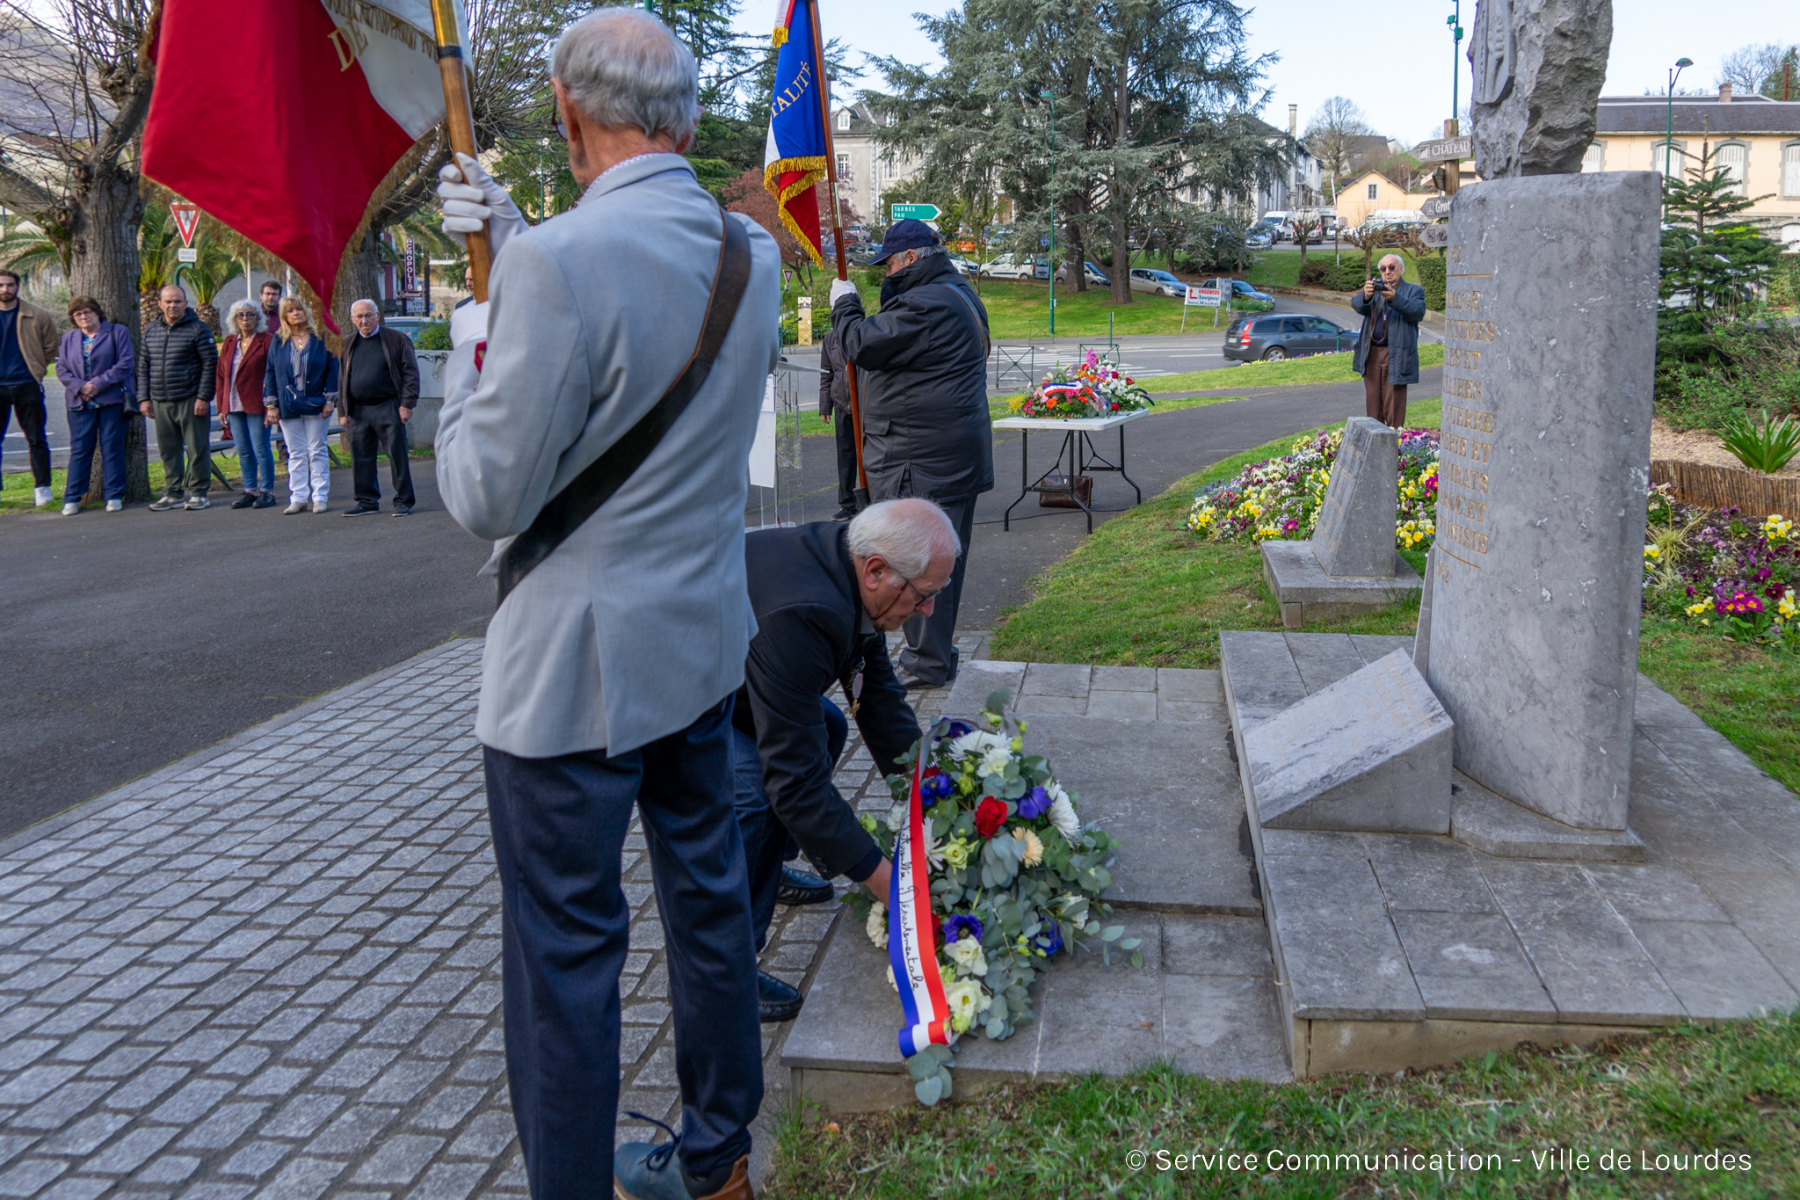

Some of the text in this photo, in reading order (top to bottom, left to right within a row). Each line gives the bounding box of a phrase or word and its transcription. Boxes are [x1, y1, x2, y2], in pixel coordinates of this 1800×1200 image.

[327, 18, 369, 72] DE
[1463, 350, 1481, 371] ET
[1470, 440, 1491, 464] ET
[1466, 499, 1487, 523] ET
